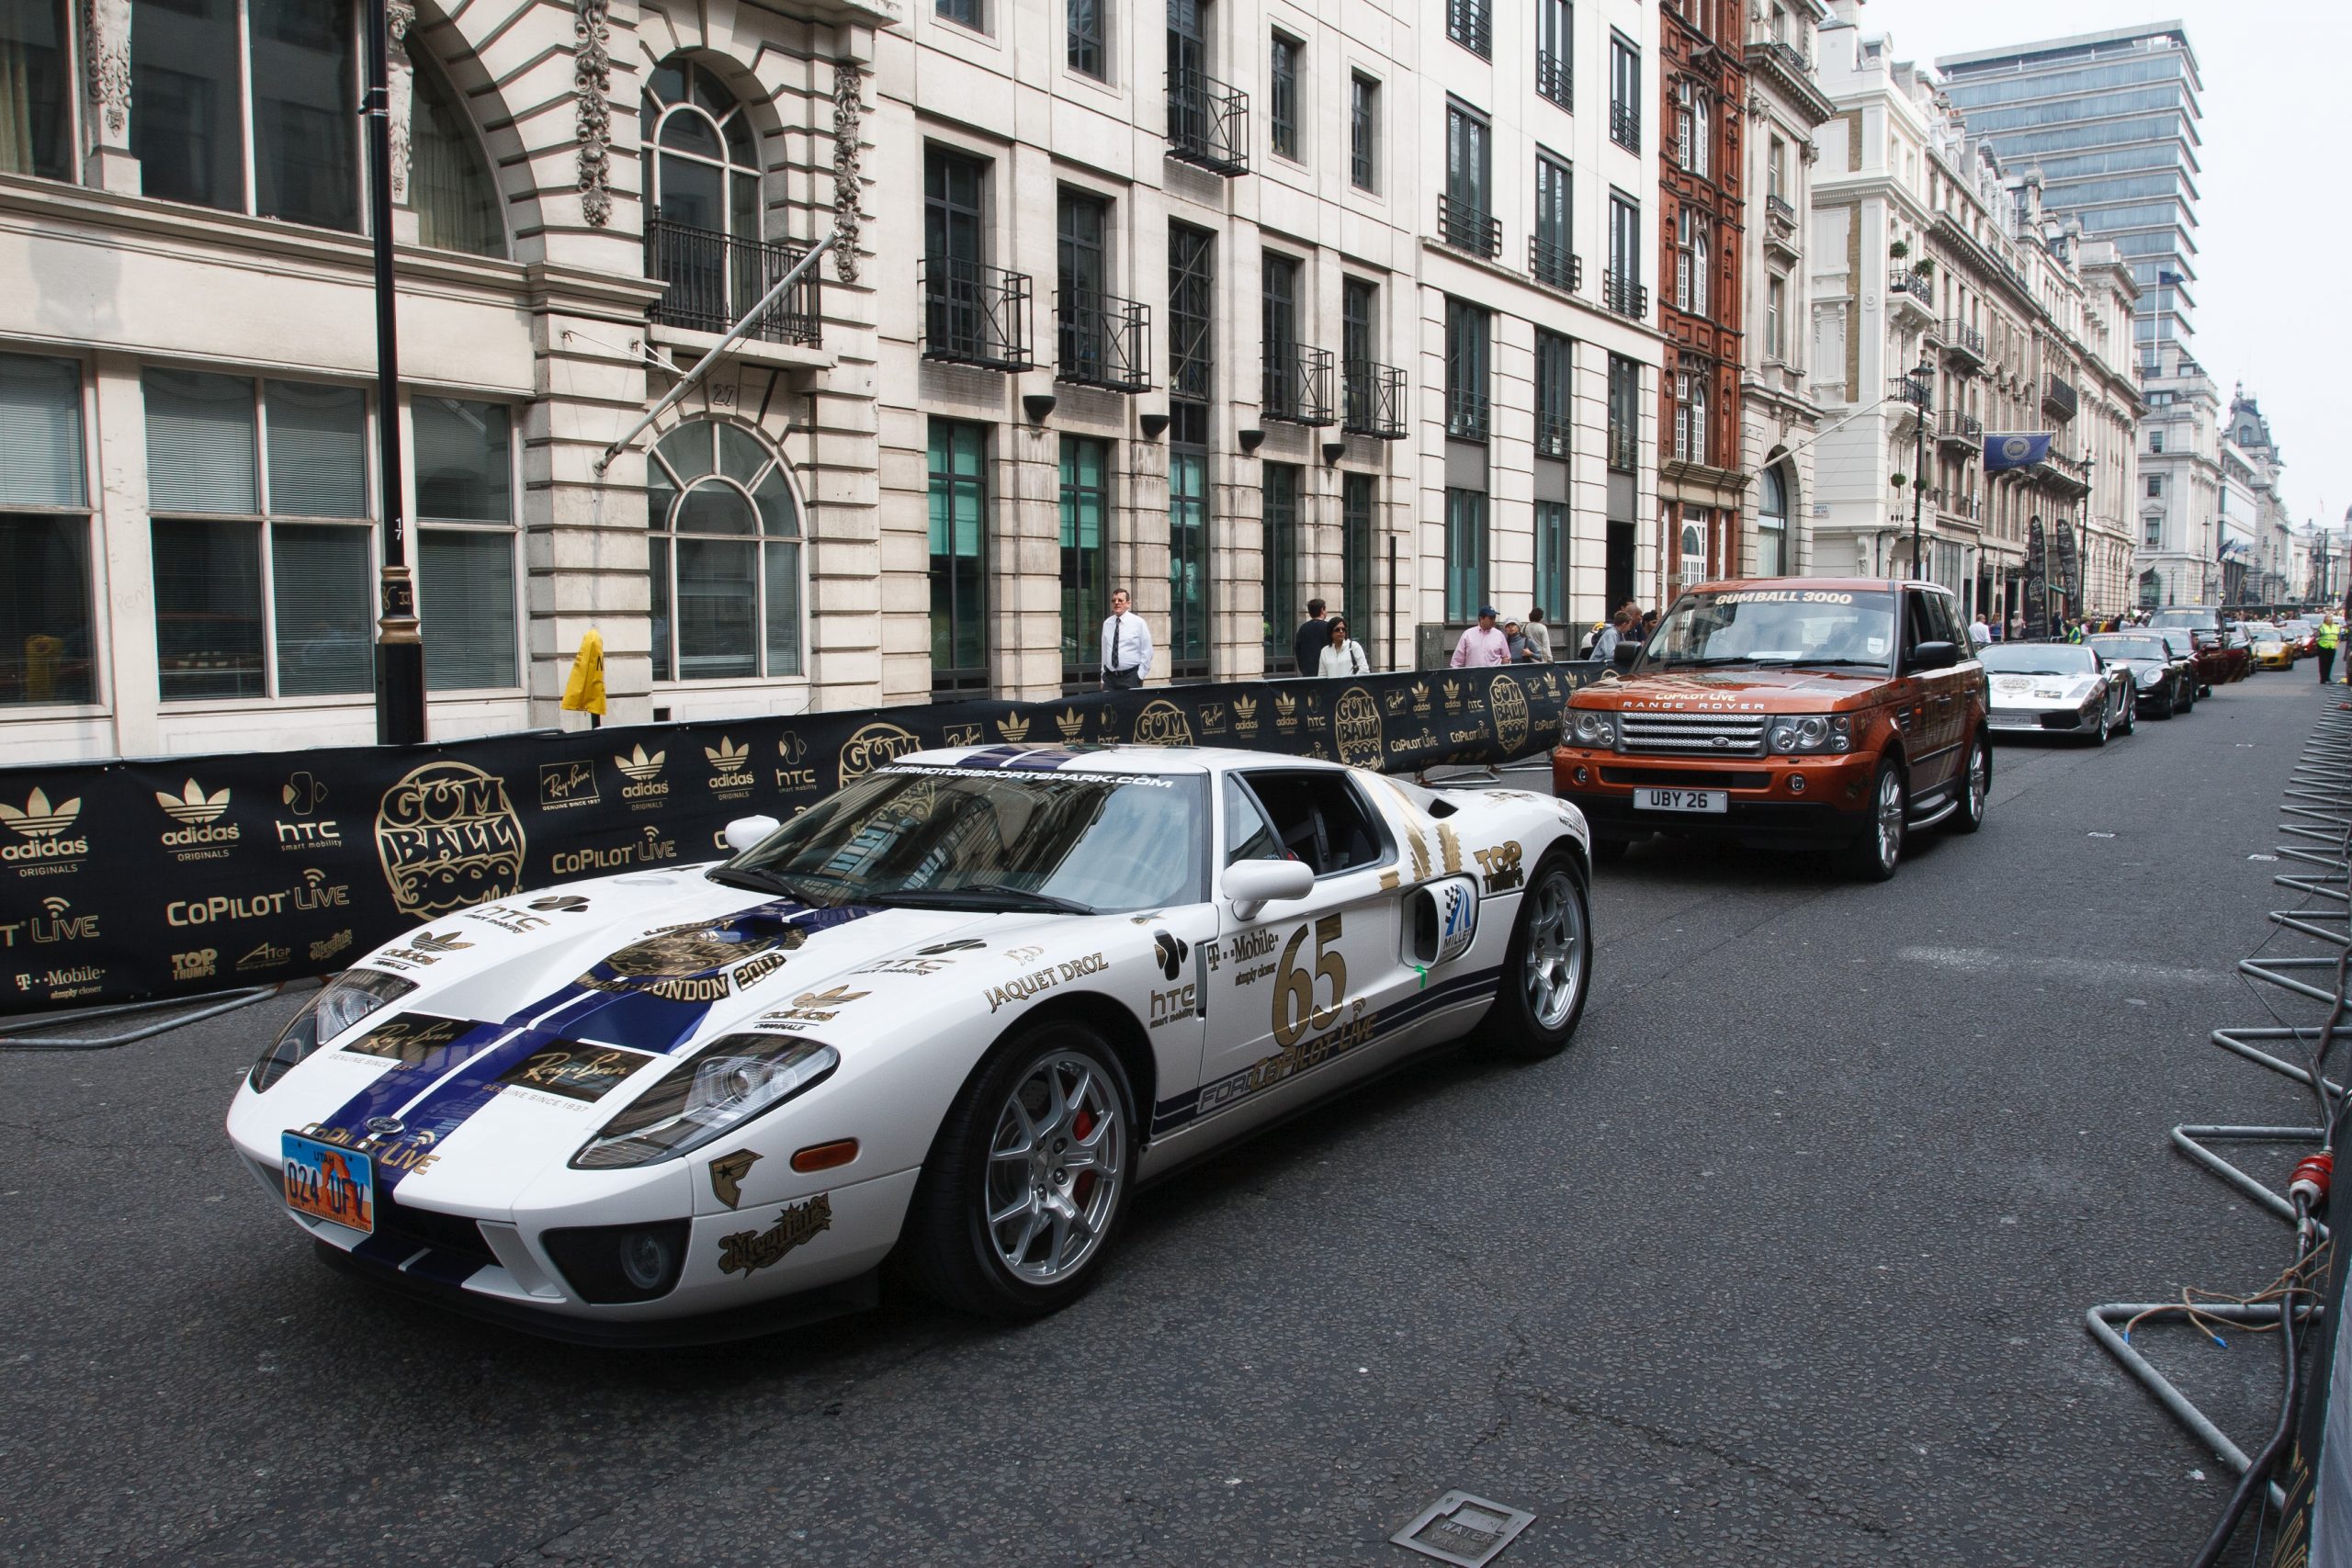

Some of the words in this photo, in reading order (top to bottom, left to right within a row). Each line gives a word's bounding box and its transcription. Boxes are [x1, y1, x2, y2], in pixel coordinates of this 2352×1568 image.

[713, 382, 736, 407] 27
[1714, 591, 1799, 605] GUMBALL
[1802, 591, 1853, 604] 3000
[1623, 701, 1685, 709] RANGE
[1235, 719, 1259, 731] adidas
[1276, 716, 1298, 728] adidas
[708, 772, 754, 788] adidas
[622, 781, 670, 798] adidas
[718, 791, 750, 801] ORIGINALS
[381, 778, 509, 828] GUM
[1650, 791, 1683, 807] UBY
[1686, 793, 1708, 808] 26
[162, 824, 241, 846] adidas
[380, 816, 520, 869] BALL
[1, 837, 90, 861] adidas
[281, 842, 306, 852] smart
[308, 840, 343, 850] mobility
[177, 849, 230, 862] ORIGINALS
[1473, 840, 1523, 875] TOP
[19, 863, 79, 878] ORIGINALS
[172, 948, 219, 971] TOP
[173, 964, 216, 981] TRUMPS
[1272, 912, 1347, 1048] 65
[983, 967, 1059, 1014] JAQUET
[1057, 953, 1110, 982] DROZ
[523, 1052, 627, 1085] Ray-Ban
[482, 1084, 526, 1100] GENUINE
[527, 1093, 562, 1107] SINCE
[562, 1101, 590, 1113] 1937
[313, 1150, 335, 1163] UTAH
[1441, 1520, 1494, 1544] WATER
